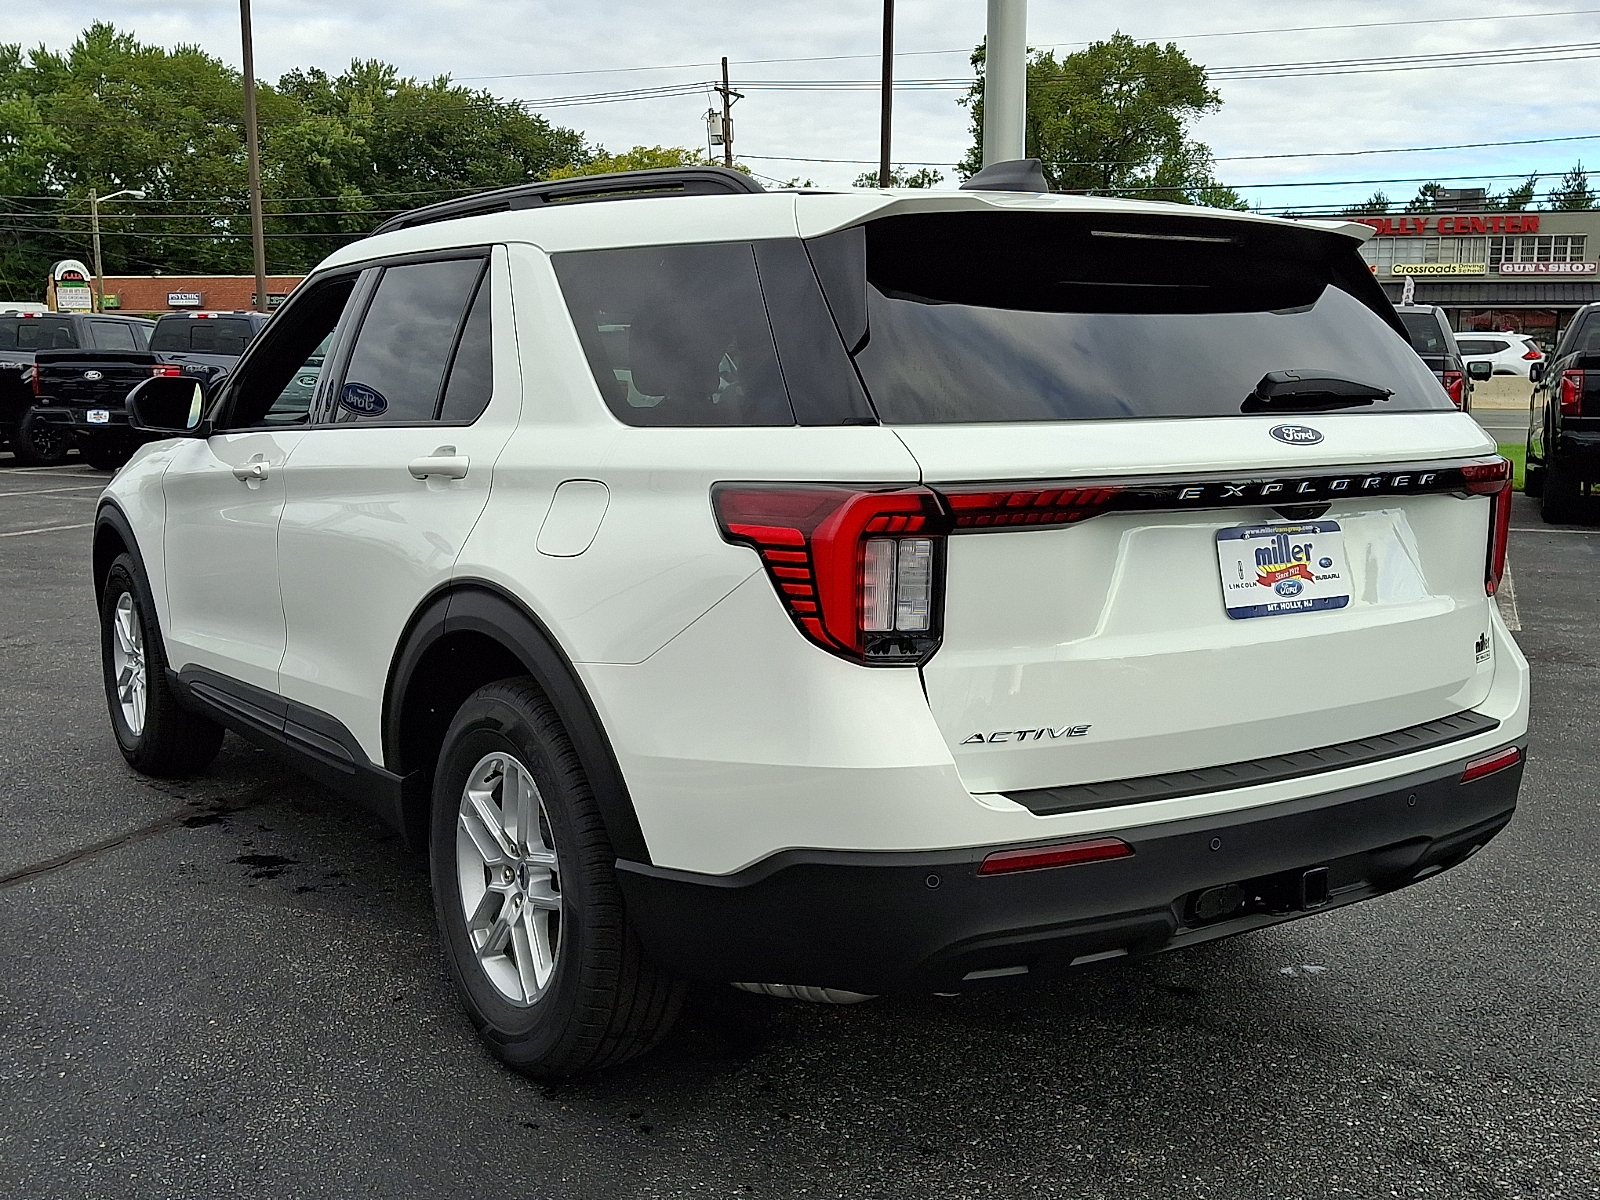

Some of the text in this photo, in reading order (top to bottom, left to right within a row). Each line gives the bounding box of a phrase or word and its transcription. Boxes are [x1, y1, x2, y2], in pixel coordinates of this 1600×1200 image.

[1438, 215, 1540, 233] CENTER
[1393, 264, 1457, 273] Crossroads
[1502, 263, 1595, 272] GUN SHOP
[1280, 426, 1316, 441] Ford
[1177, 473, 1436, 500] EXPLORER
[1255, 534, 1313, 566] miller
[1275, 567, 1300, 580] Since 1912
[1315, 573, 1340, 581] SUBARU
[1228, 581, 1258, 590] LINCOLN
[1280, 580, 1298, 594] Ford
[1267, 603, 1279, 611] MT.
[1280, 601, 1302, 610] HOLLY,
[959, 724, 1092, 745] ACTIVE
